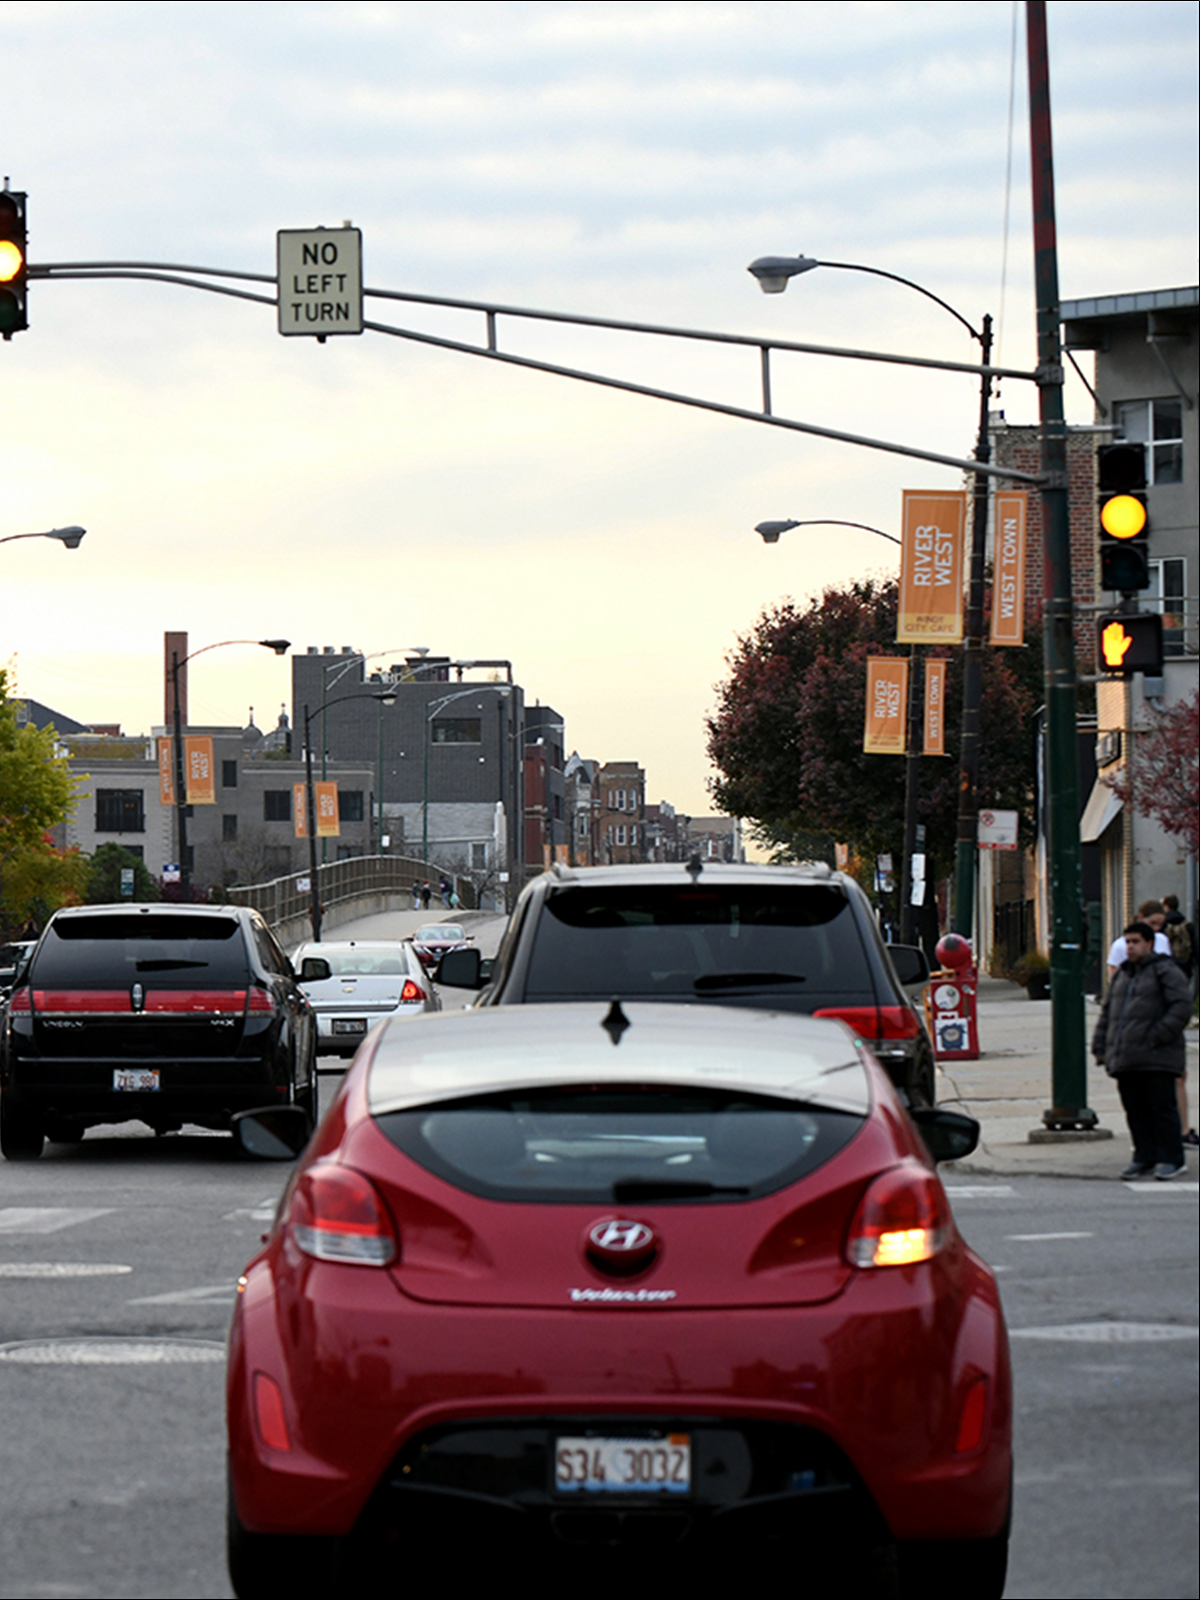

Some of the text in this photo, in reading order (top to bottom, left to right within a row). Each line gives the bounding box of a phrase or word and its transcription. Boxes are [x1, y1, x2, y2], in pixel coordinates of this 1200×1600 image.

[303, 242, 338, 265] NO
[293, 273, 348, 294] LEFT
[291, 302, 349, 322] TURN
[914, 525, 934, 586] RIVER
[934, 528, 953, 587] WEST
[1001, 518, 1018, 619] WEST TOWN
[905, 624, 927, 633] CITY
[874, 679, 887, 718] RIVER
[887, 681, 900, 719] WEST
[929, 675, 939, 738] WEST TOWN
[557, 1448, 685, 1483] S34 3032
